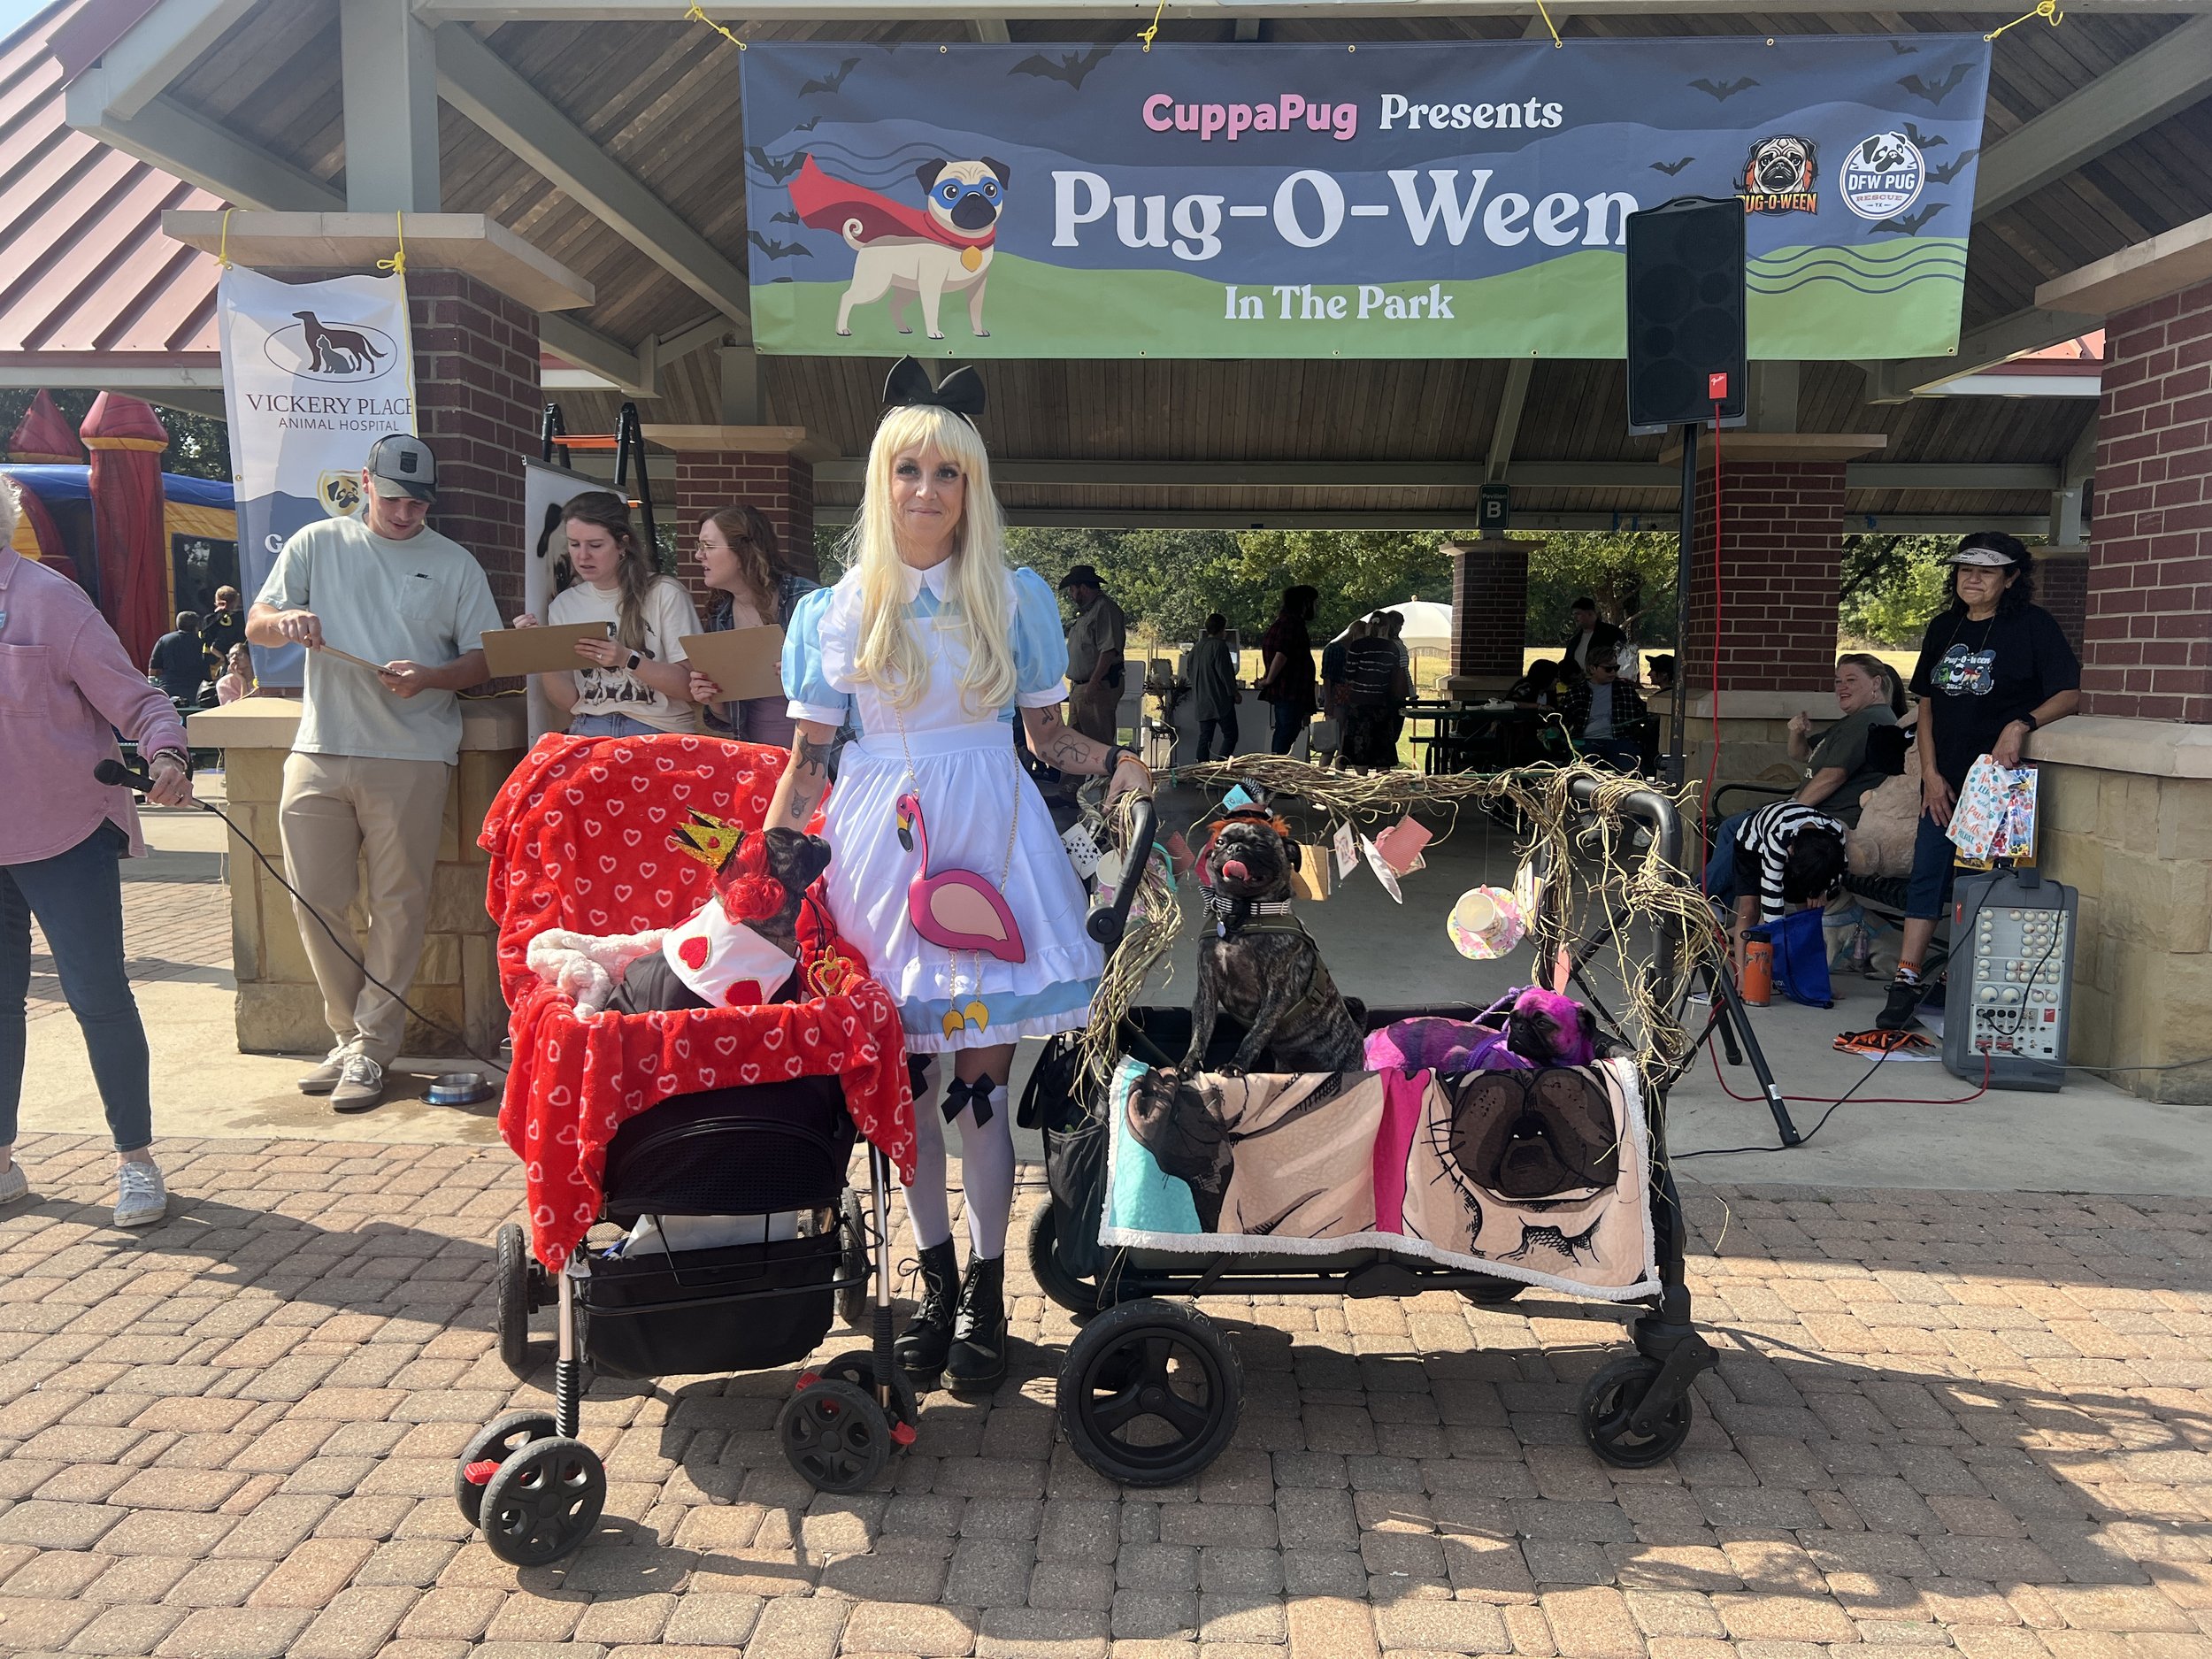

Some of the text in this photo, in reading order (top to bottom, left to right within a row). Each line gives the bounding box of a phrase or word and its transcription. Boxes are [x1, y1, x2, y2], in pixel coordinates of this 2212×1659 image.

[1141, 93, 1563, 142] CuppaPug Presents
[1848, 173, 1916, 191] DFW PUG
[1855, 193, 1903, 203] RESCUE
[1050, 168, 1640, 261] Pug-O-Ween
[1224, 282, 1455, 320] In The Park
[245, 393, 413, 416] VICKERY PLACE
[278, 417, 400, 432] ANIMAL HOSPITAL
[1486, 501, 1502, 518] B
